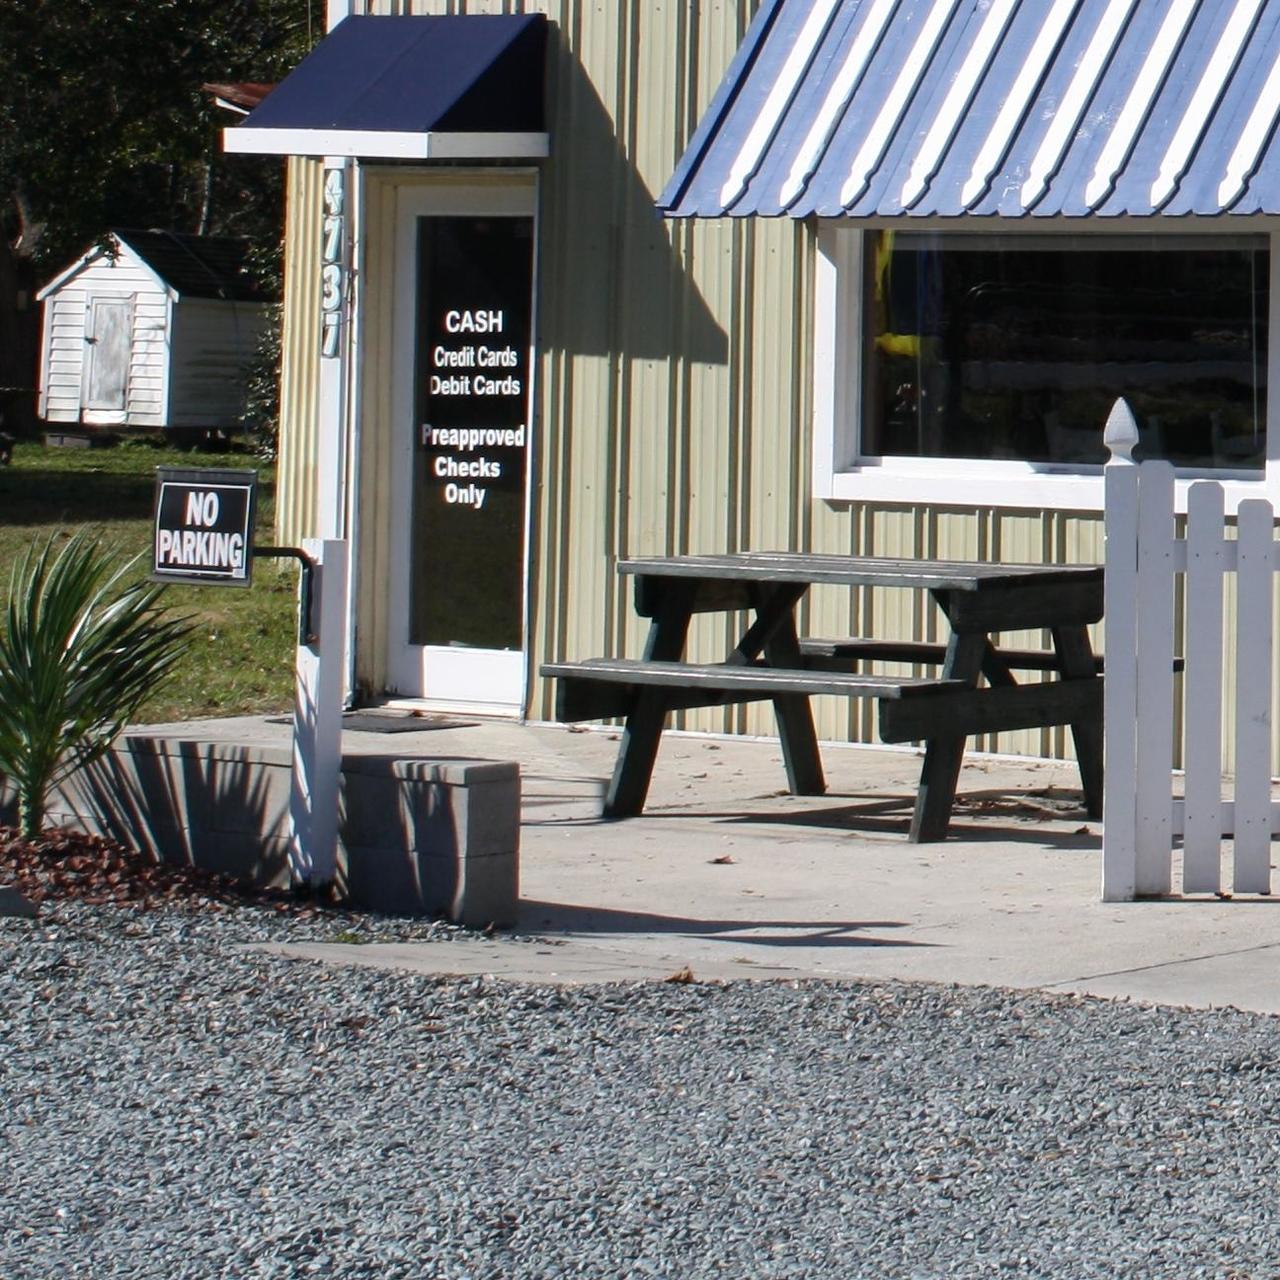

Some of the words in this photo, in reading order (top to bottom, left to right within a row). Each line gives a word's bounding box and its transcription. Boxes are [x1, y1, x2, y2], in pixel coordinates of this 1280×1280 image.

[322, 169, 342, 358] 4737
[446, 311, 502, 332] CASH
[434, 346, 475, 367] Credit
[478, 346, 517, 367] Cards
[430, 375, 470, 395] Debit
[474, 375, 520, 395] Cards
[422, 424, 524, 450] Preapproved
[435, 456, 501, 477] Checks
[445, 483, 485, 508] Only
[185, 491, 219, 527] NO
[159, 529, 243, 568] PARKING
